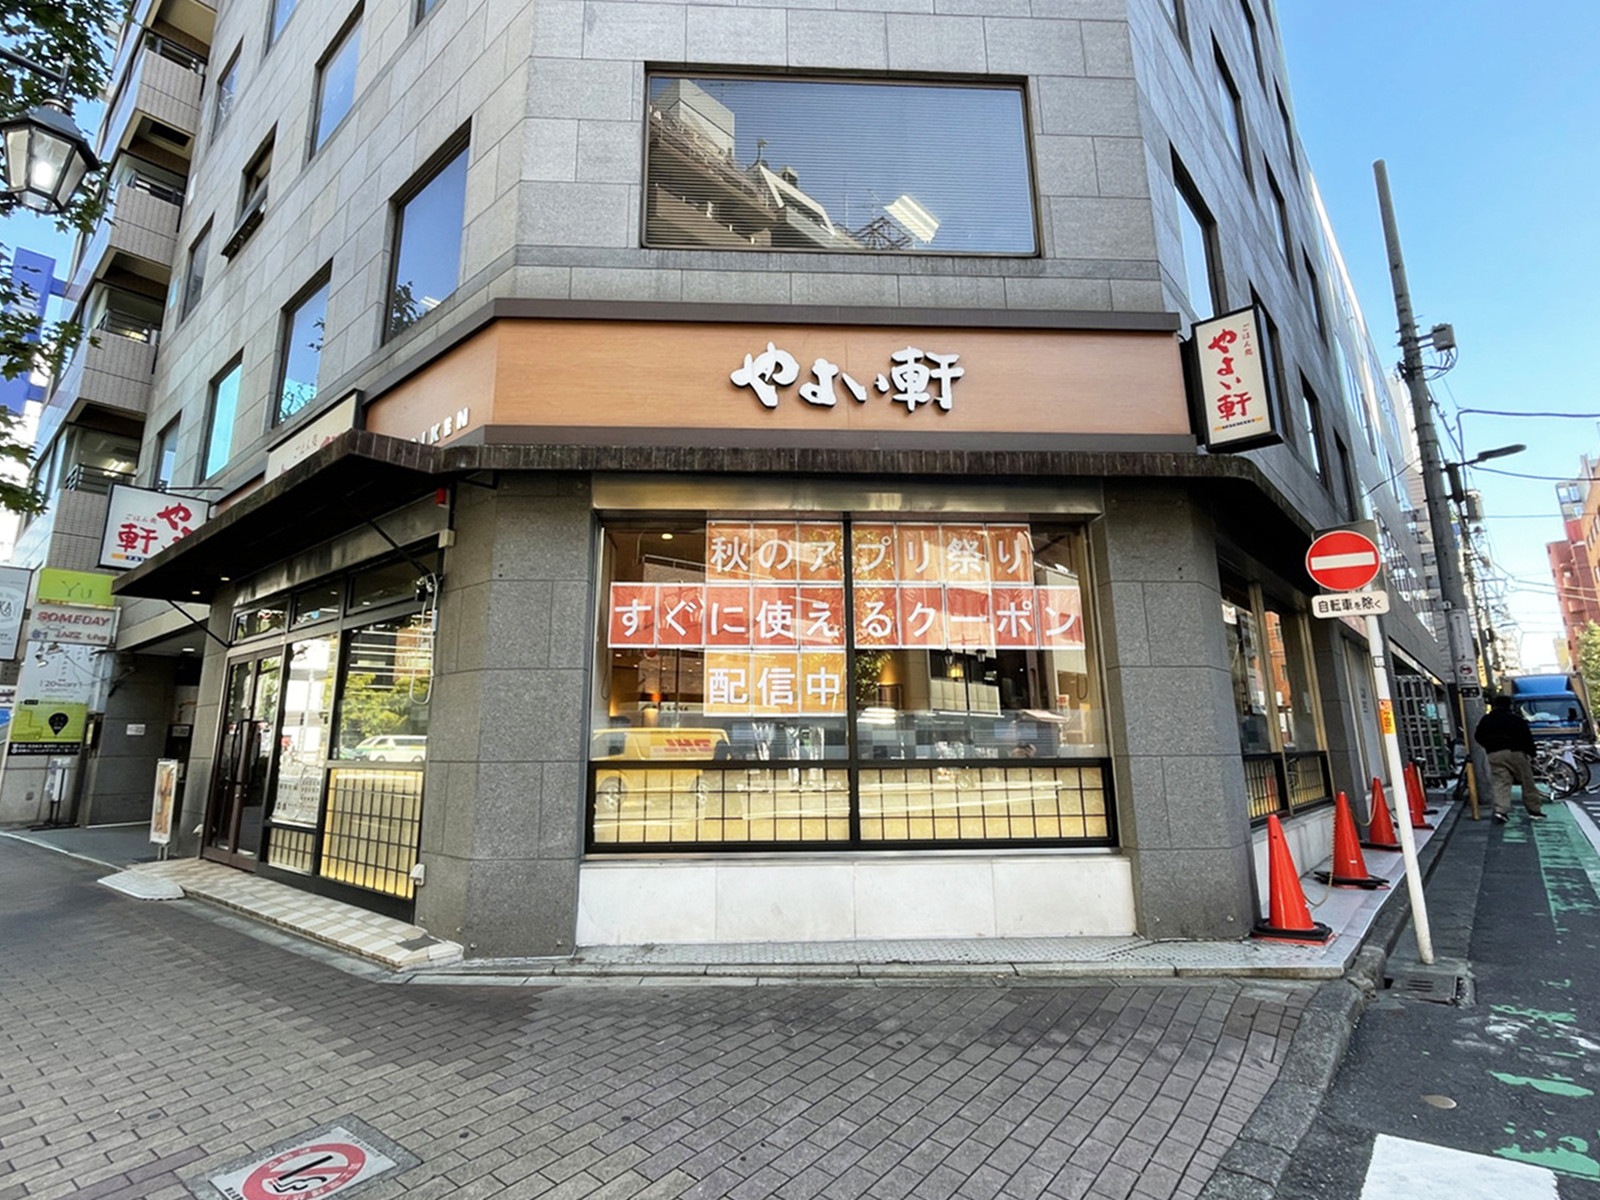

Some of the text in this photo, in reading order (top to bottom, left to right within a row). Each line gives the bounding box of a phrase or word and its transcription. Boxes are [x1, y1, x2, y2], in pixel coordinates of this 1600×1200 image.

[730, 341, 965, 413] やよい軒
[1208, 328, 1252, 421] やよい軒
[710, 536, 1023, 575] 秋のアプリ祭り
[37, 611, 110, 627] SOMEDAY
[614, 598, 1077, 637] すぐに使えるクーポン
[1318, 596, 1382, 613] 自転車を除く
[55, 630, 82, 640] JAZZ
[708, 666, 841, 706] 配信中
